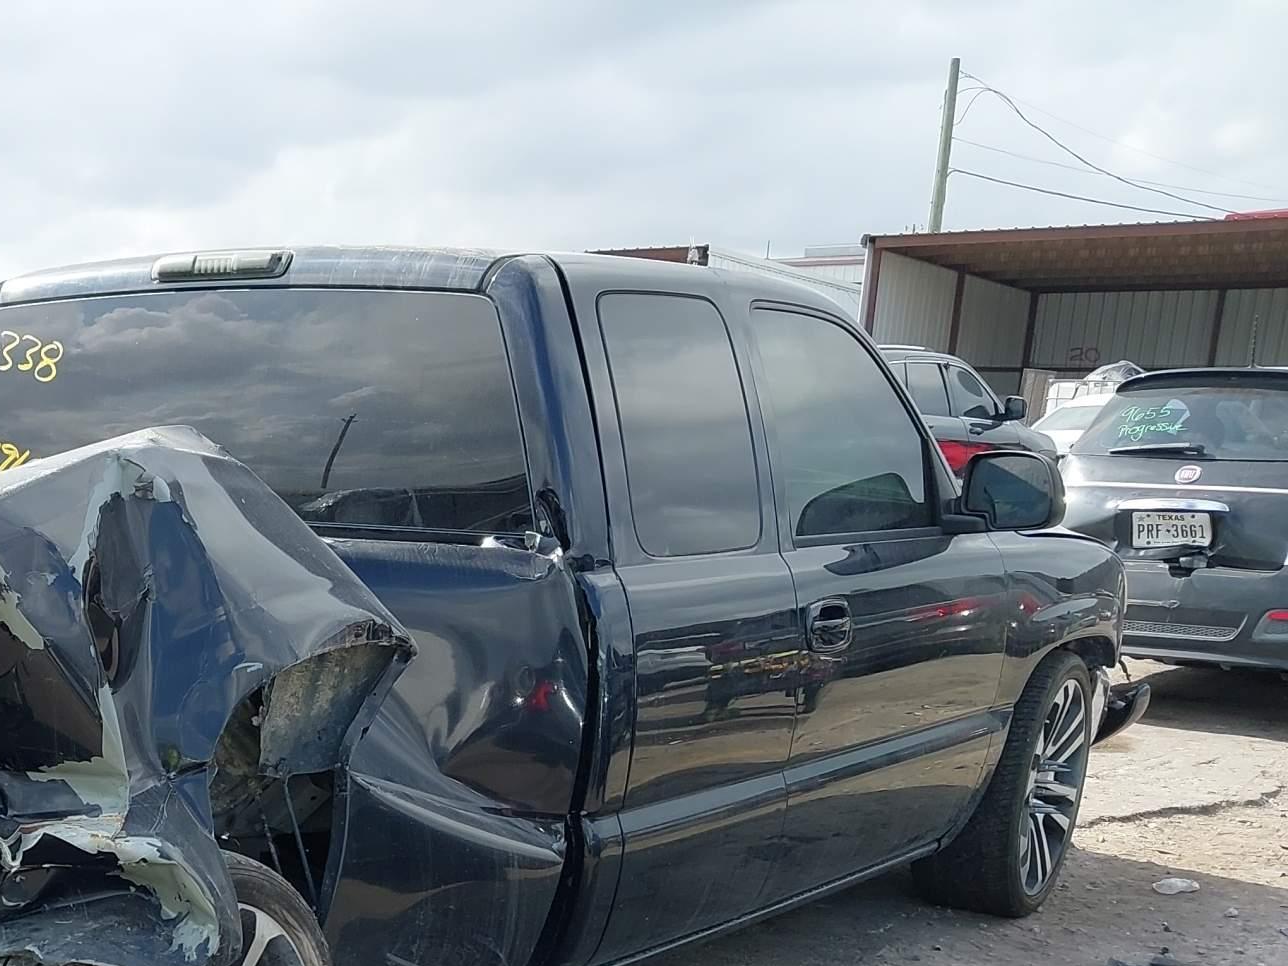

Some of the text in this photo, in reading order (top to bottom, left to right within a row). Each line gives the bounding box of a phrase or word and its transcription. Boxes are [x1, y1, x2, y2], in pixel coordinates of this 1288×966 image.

[1119, 405, 1172, 422] 9655
[1156, 514, 1185, 522] TEXAS
[1137, 523, 1207, 540] PRF 3661
